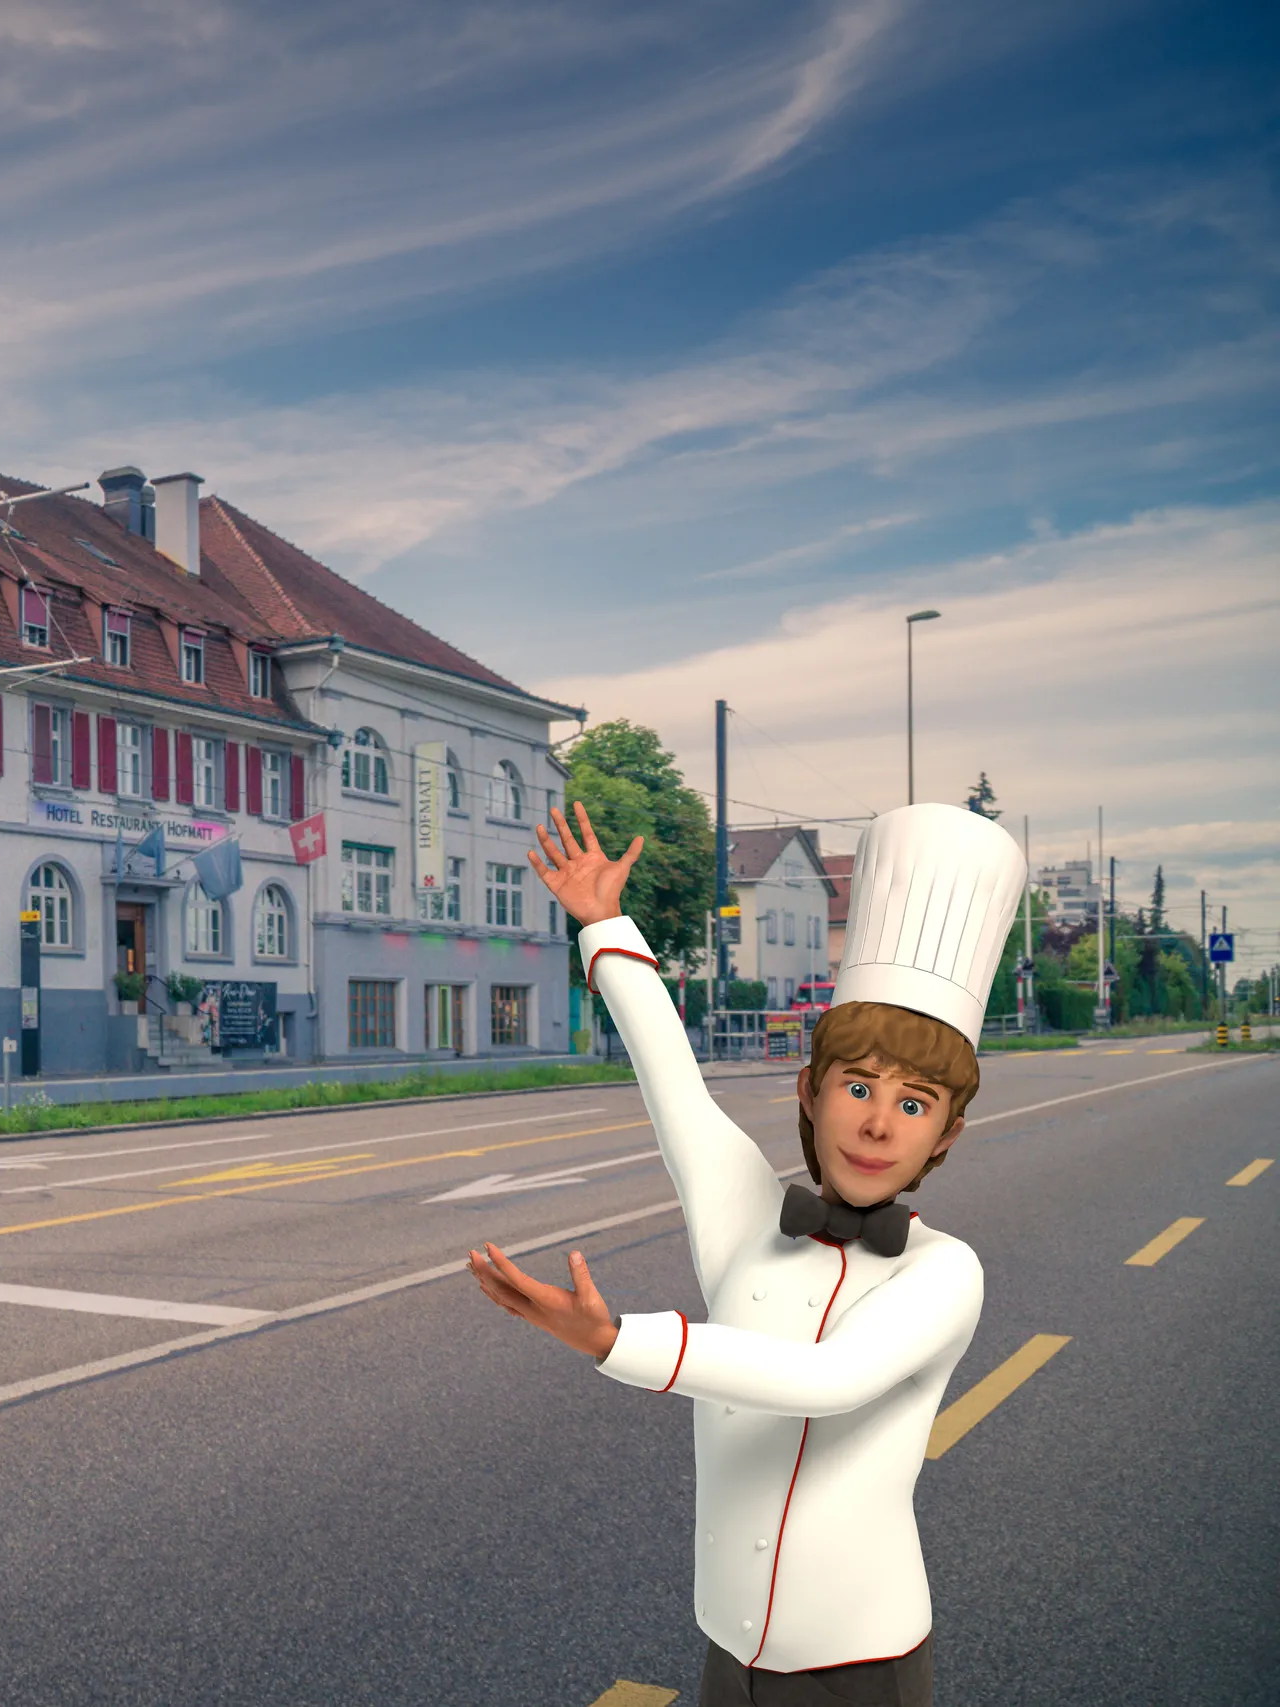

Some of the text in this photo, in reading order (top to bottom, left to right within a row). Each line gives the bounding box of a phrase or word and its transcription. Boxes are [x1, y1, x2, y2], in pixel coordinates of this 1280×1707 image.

[46, 803, 83, 825] HOTEL
[167, 820, 213, 840] HOFMATT
[418, 767, 431, 849] HOFMATT
